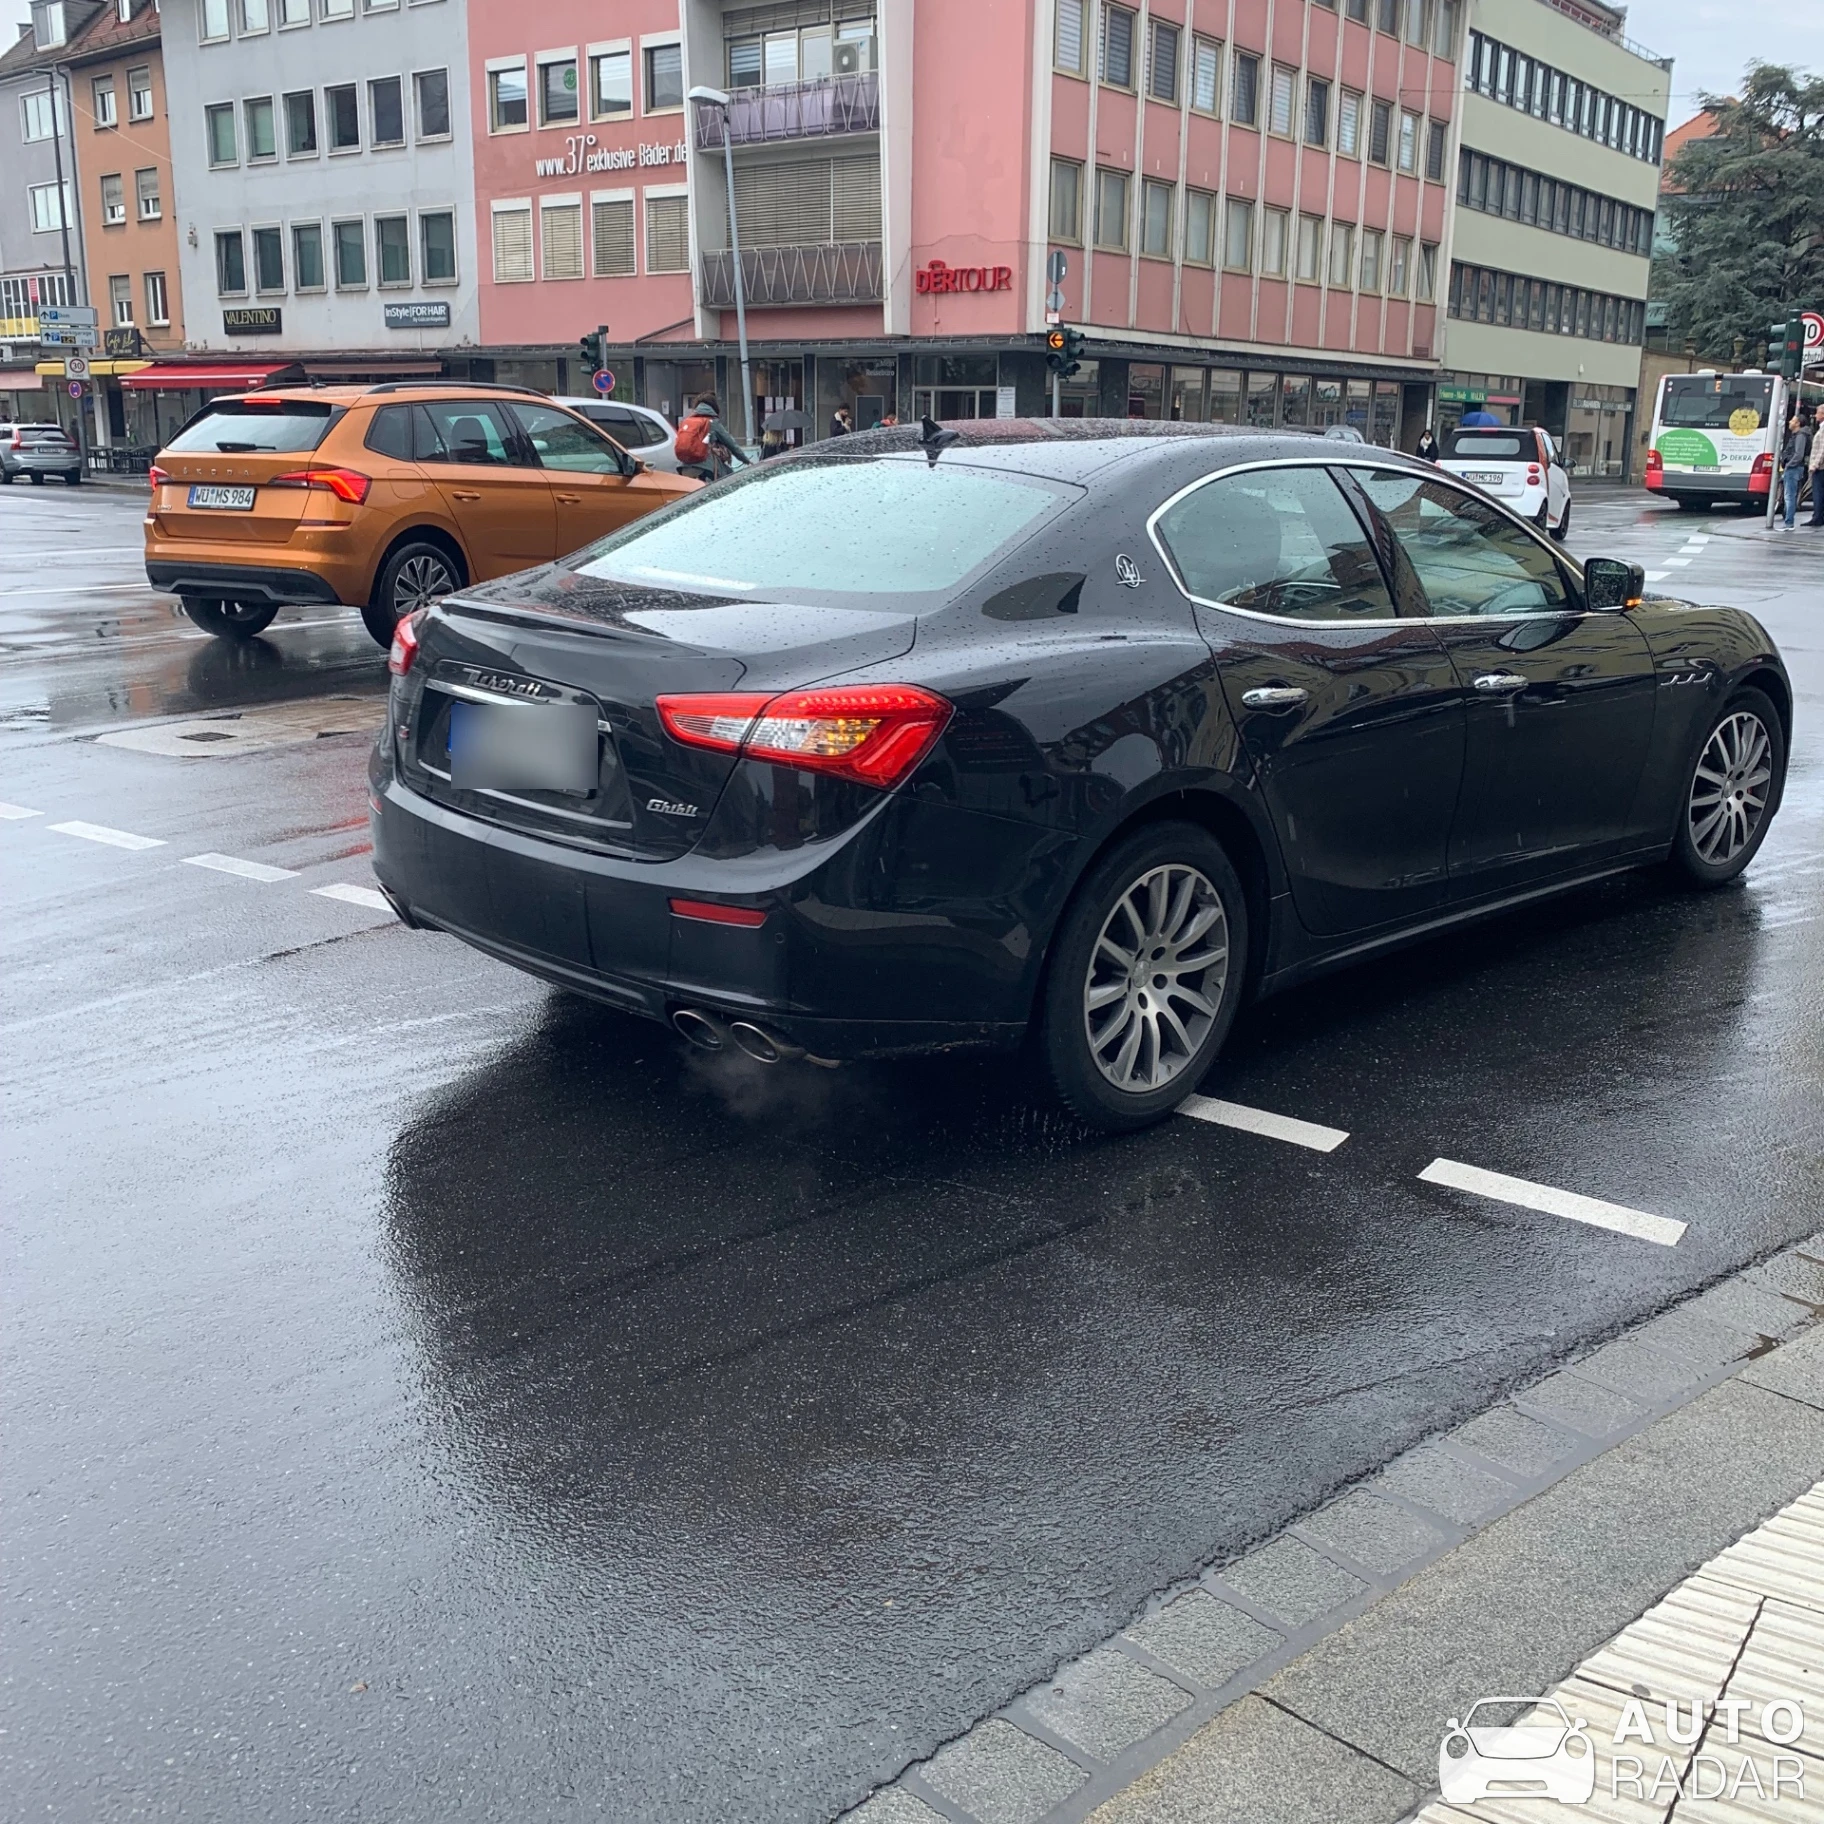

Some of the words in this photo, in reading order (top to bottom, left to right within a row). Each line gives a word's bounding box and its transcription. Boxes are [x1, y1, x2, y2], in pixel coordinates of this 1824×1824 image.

[586, 147, 636, 172] exklusive
[639, 139, 687, 167] Bäder.de
[916, 266, 1012, 293] DERTOUR
[225, 309, 277, 325] VALENTINO
[412, 306, 427, 316] FOR
[428, 305, 446, 315] HAIR
[72, 362, 82, 370] 30
[1729, 454, 1753, 462] DEKRA
[1489, 474, 1501, 482] 196
[196, 488, 210, 503] WÜ
[215, 488, 231, 504] MS
[231, 489, 253, 505] 984
